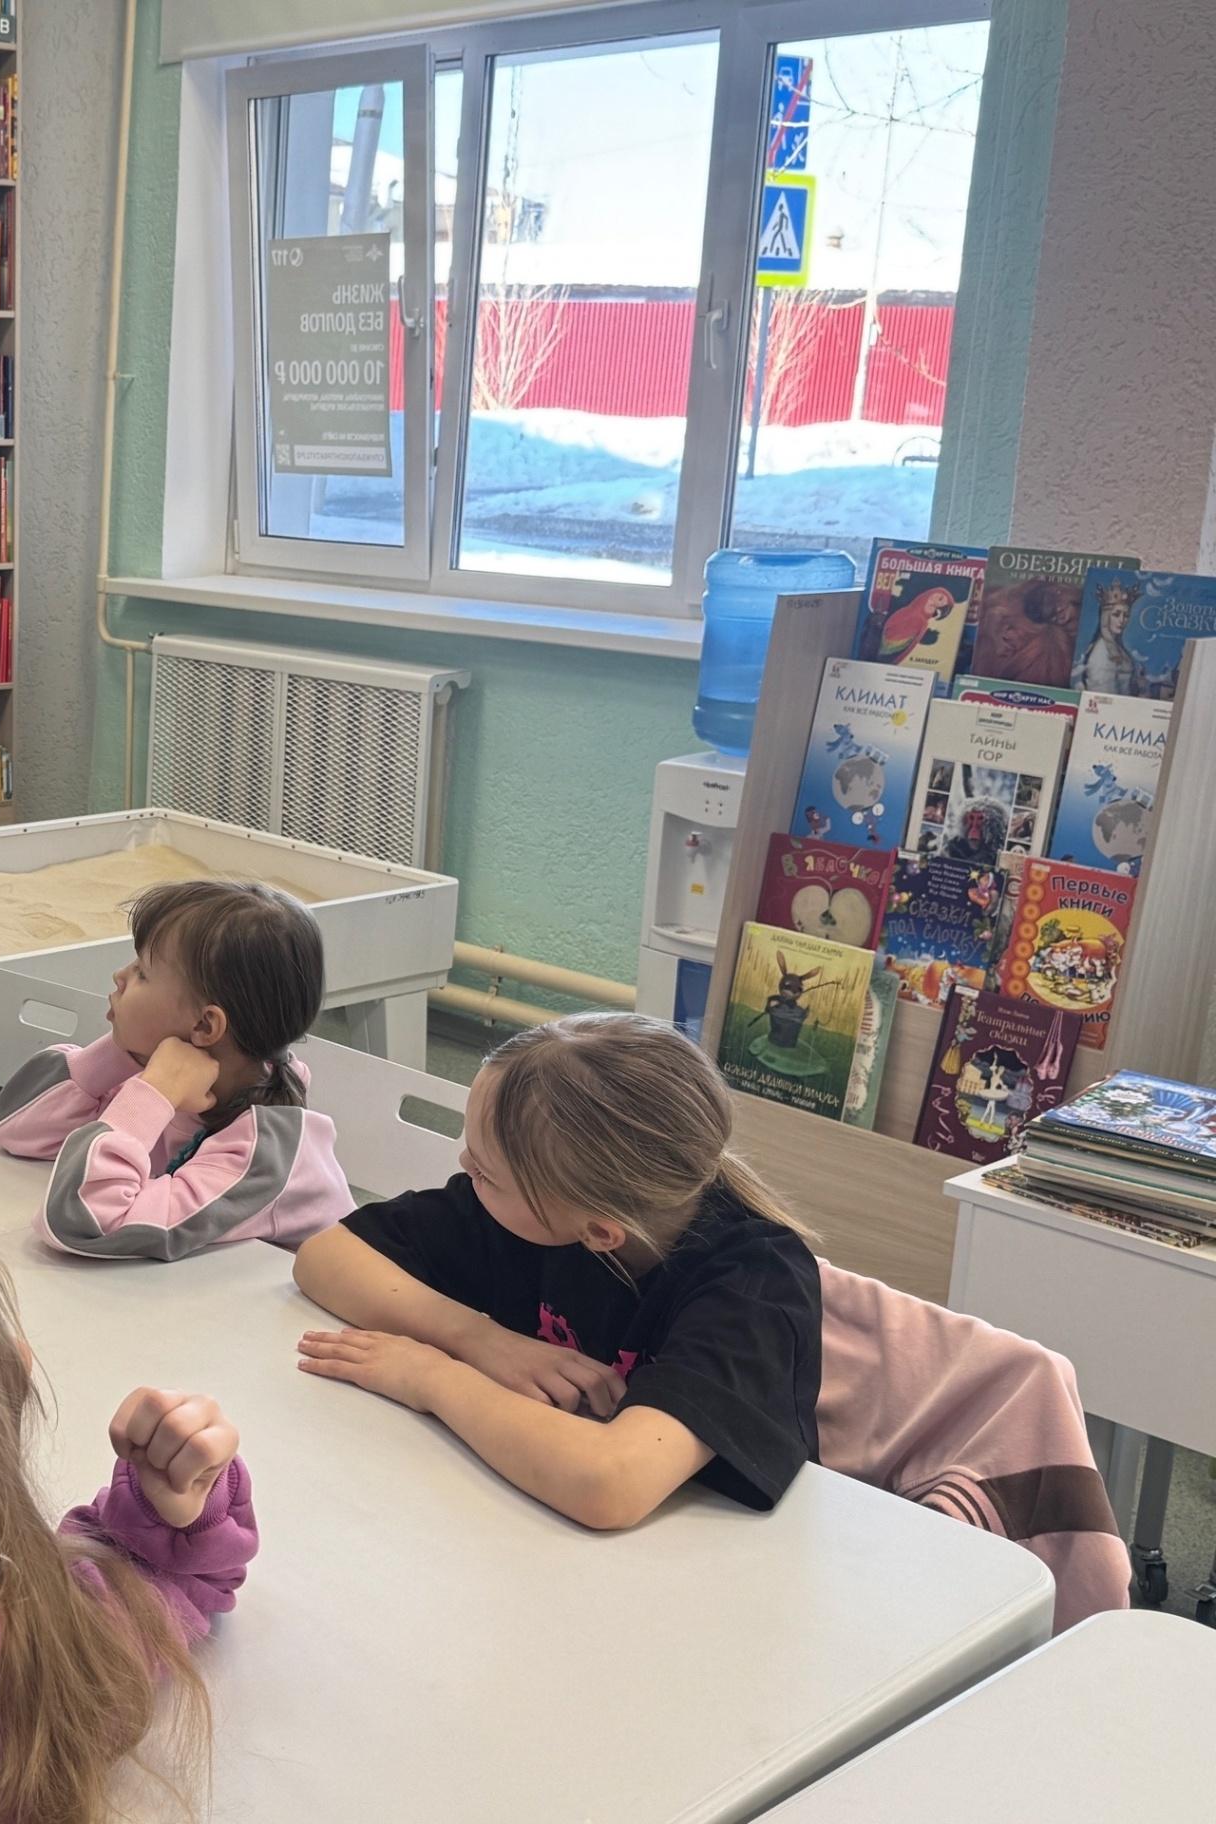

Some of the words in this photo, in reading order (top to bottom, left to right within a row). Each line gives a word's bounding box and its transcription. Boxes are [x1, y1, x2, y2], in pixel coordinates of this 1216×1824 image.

[0, 18, 10, 34] В
[881, 557, 943, 574] БОЛЬШАЯ
[945, 565, 985, 580] КНИГА
[835, 686, 908, 709] КЛИМАТ
[969, 733, 1016, 751] ТАЙНЫ
[977, 749, 1003, 762] ГОР
[1051, 876, 1129, 905] Первые
[1059, 897, 1115, 918] книги
[975, 1009, 1047, 1039] Театральные
[989, 1029, 1029, 1047] сказки
